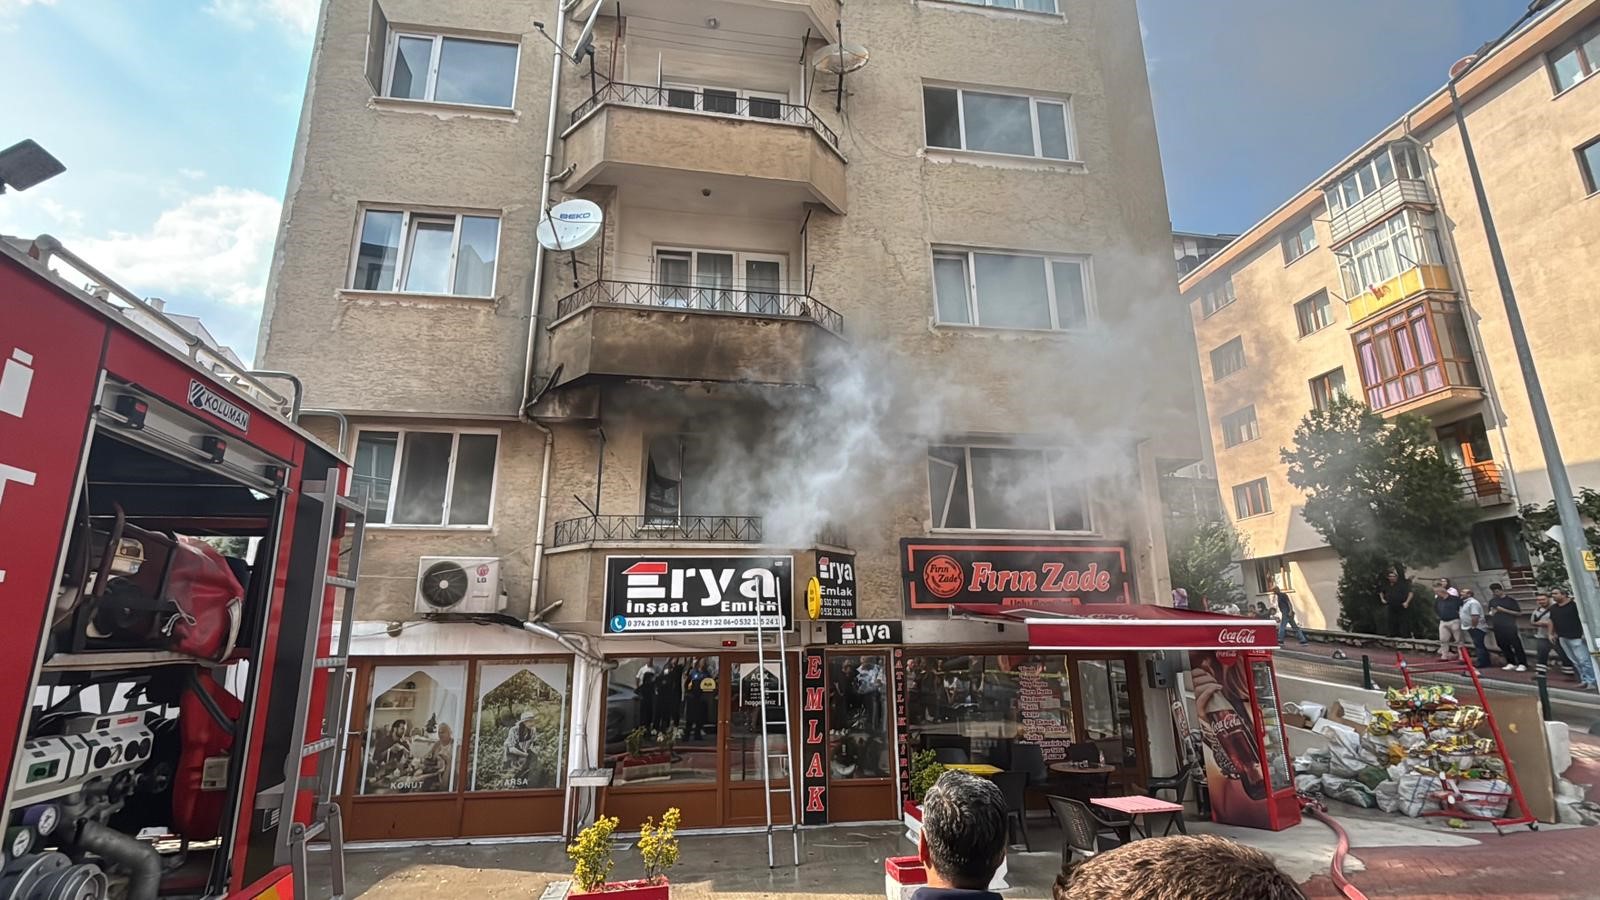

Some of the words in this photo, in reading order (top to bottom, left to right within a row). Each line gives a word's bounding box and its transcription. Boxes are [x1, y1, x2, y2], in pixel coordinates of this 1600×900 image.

[560, 212, 591, 220] BEKO
[204, 393, 248, 427] KOLUMAN
[819, 556, 853, 584] Erya
[938, 574, 958, 583] Zade
[968, 562, 1036, 592] Fırın
[1041, 562, 1110, 592] Zade
[621, 561, 776, 606] Erya
[820, 586, 853, 596] Emlak
[626, 600, 689, 615] İnşaat
[721, 600, 777, 612] Emlak
[841, 621, 891, 643] Erya
[805, 655, 825, 812] EMLAK
[390, 781, 424, 790] KONUT
[503, 778, 528, 786] ARSA
